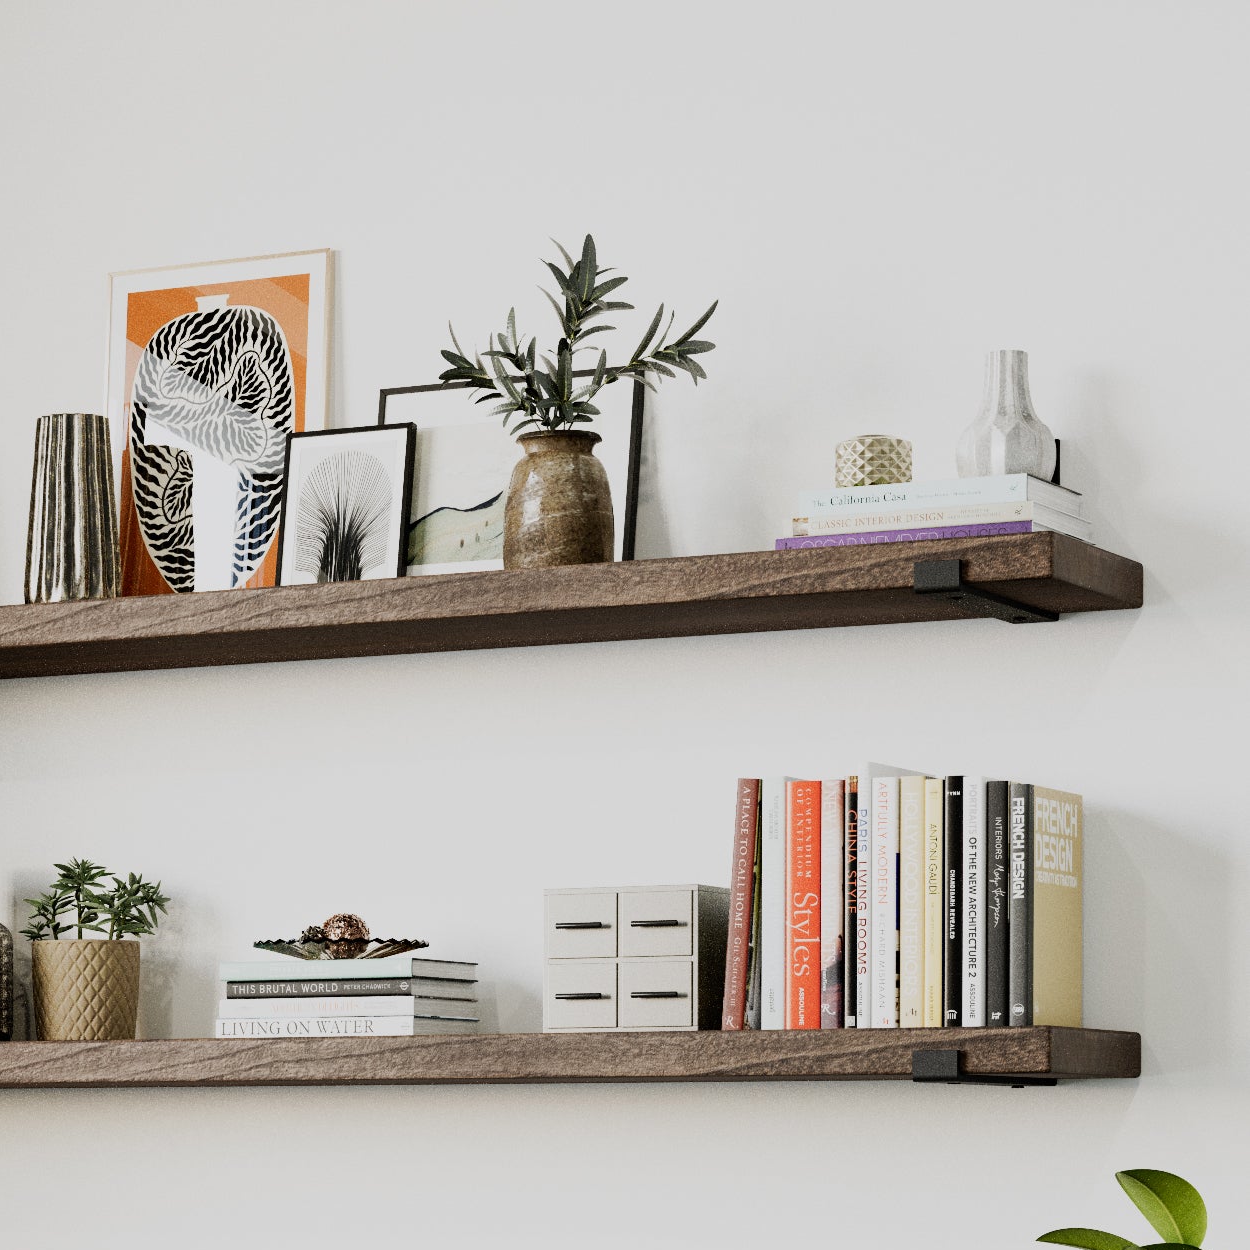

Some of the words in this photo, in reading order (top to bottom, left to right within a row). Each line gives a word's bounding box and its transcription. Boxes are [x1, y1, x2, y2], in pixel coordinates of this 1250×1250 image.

[830, 493, 880, 507] California
[883, 492, 907, 503] Casa
[818, 518, 851, 529] LASSIC
[854, 515, 901, 527] INTERIOR
[906, 512, 944, 523] DESIGN
[743, 786, 751, 794] A
[797, 789, 804, 802] OF
[878, 782, 888, 839] ARTFULLY
[969, 784, 977, 835] PORTRAITS
[740, 798, 750, 834] PLACE
[847, 809, 857, 863] CHINA
[858, 809, 867, 852] PARIS
[1012, 797, 1024, 848] FRENCH
[1035, 796, 1078, 838] FRENCH
[739, 838, 749, 855] TO
[903, 792, 919, 903] HOLLYWOOD
[928, 823, 937, 861] ANTONI
[969, 837, 977, 850] OF
[969, 852, 977, 870] THE
[1035, 833, 1073, 873] DESIGN
[737, 859, 747, 888] CALL
[847, 870, 857, 914] STYLE
[858, 861, 867, 911] LIVING
[878, 845, 888, 904] MODERN
[928, 863, 940, 895] GAUDÍ
[969, 872, 977, 894] NEW
[1012, 852, 1024, 899] DESIGN
[734, 892, 744, 929] HOME
[786, 892, 820, 977] Styles
[858, 918, 867, 975] ROOMS
[878, 913, 886, 955] RICHARD
[903, 907, 919, 998] INTERIORS
[969, 897, 977, 969] ARCHITECTURE
[232, 985, 256, 995] THIS
[259, 984, 297, 994] BRUTAL
[301, 983, 338, 993] WORLD
[222, 1021, 280, 1036] LIVING
[286, 1021, 310, 1035] ON
[317, 1020, 374, 1034] WATER
